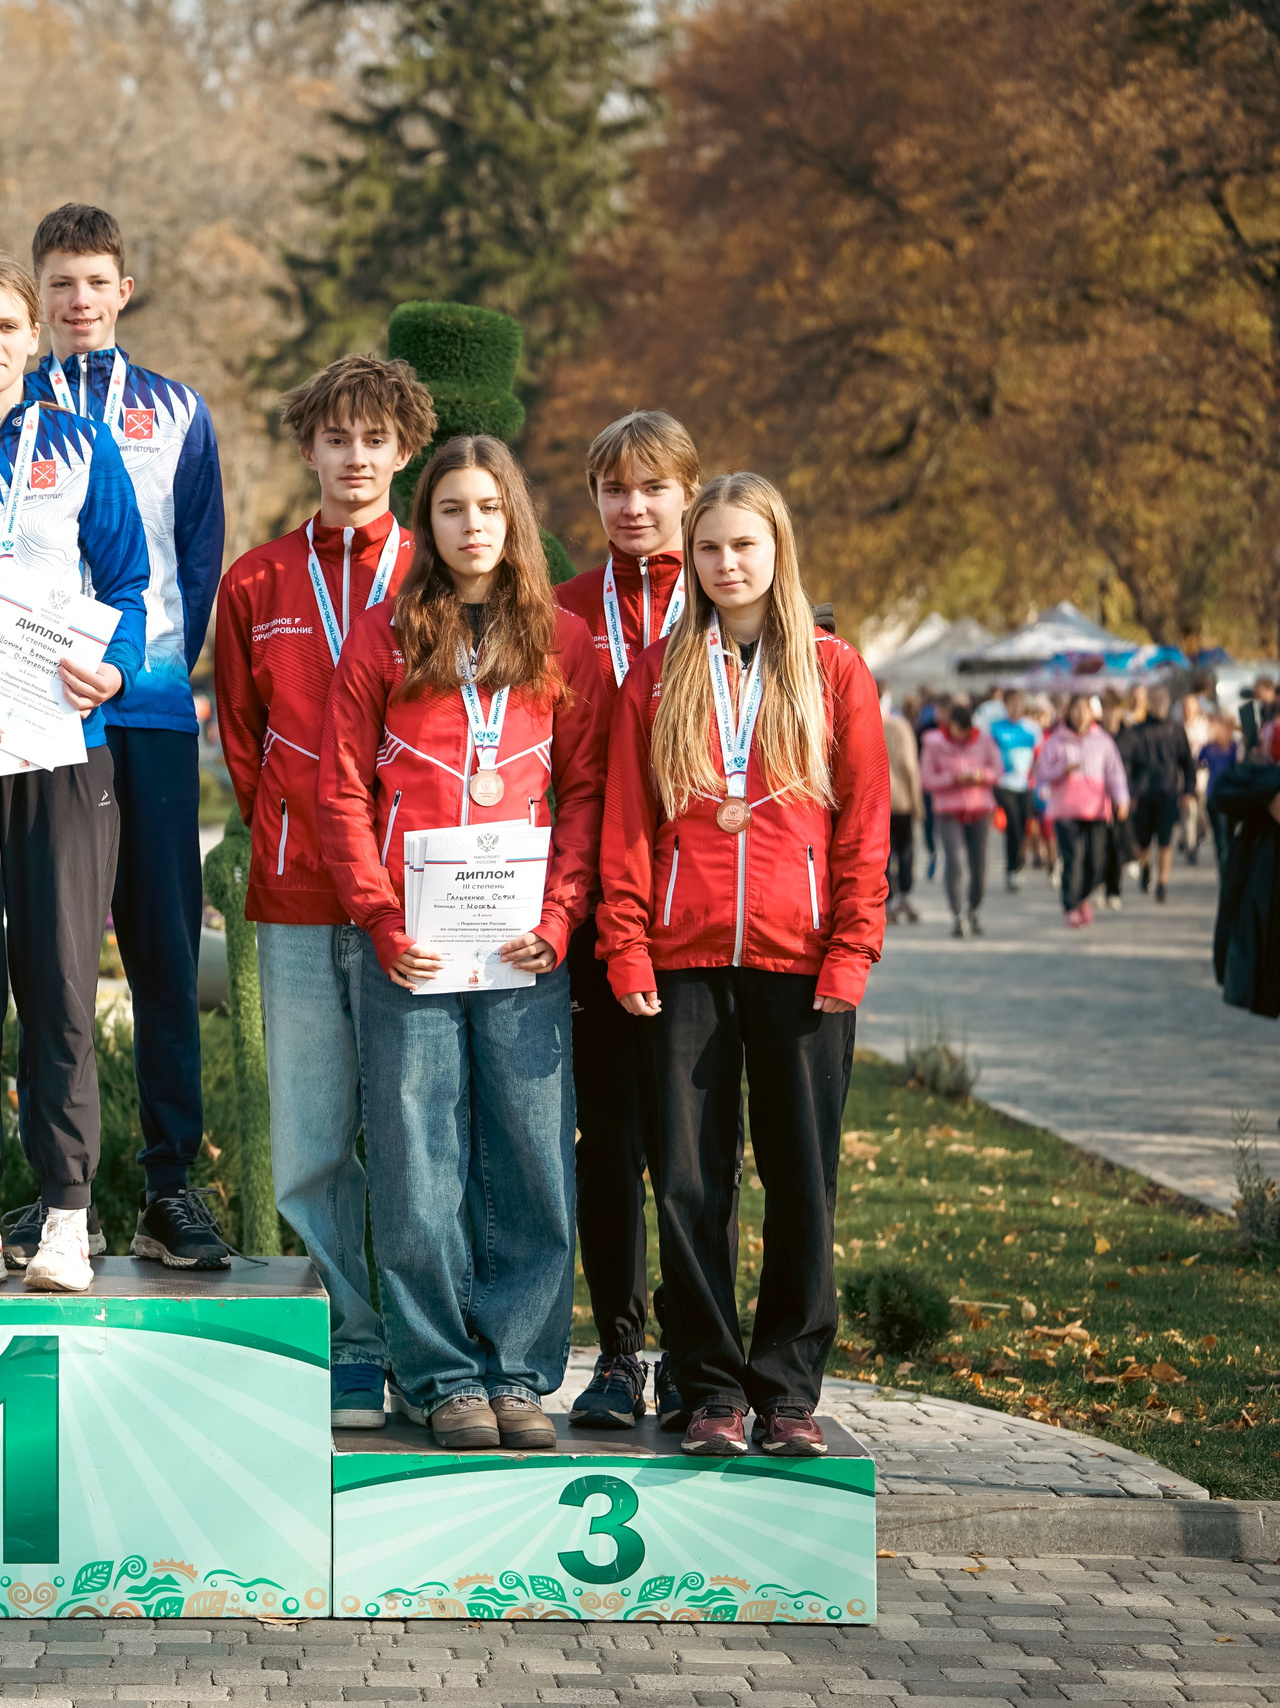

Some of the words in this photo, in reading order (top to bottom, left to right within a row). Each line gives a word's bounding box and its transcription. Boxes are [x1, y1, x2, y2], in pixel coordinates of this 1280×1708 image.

[8, 487, 21, 534] МИНИСТЕРСТВО
[311, 562, 321, 587] РОССИИ
[318, 587, 327, 610] СПОРТА
[15, 617, 74, 649] ДИПЛОМ
[25, 636, 57, 654] степень
[615, 646, 624, 669] СПОРТА
[470, 699, 480, 724] РОССИИ
[455, 870, 515, 881] ДИПЛОМ
[557, 1474, 646, 1585] 3
